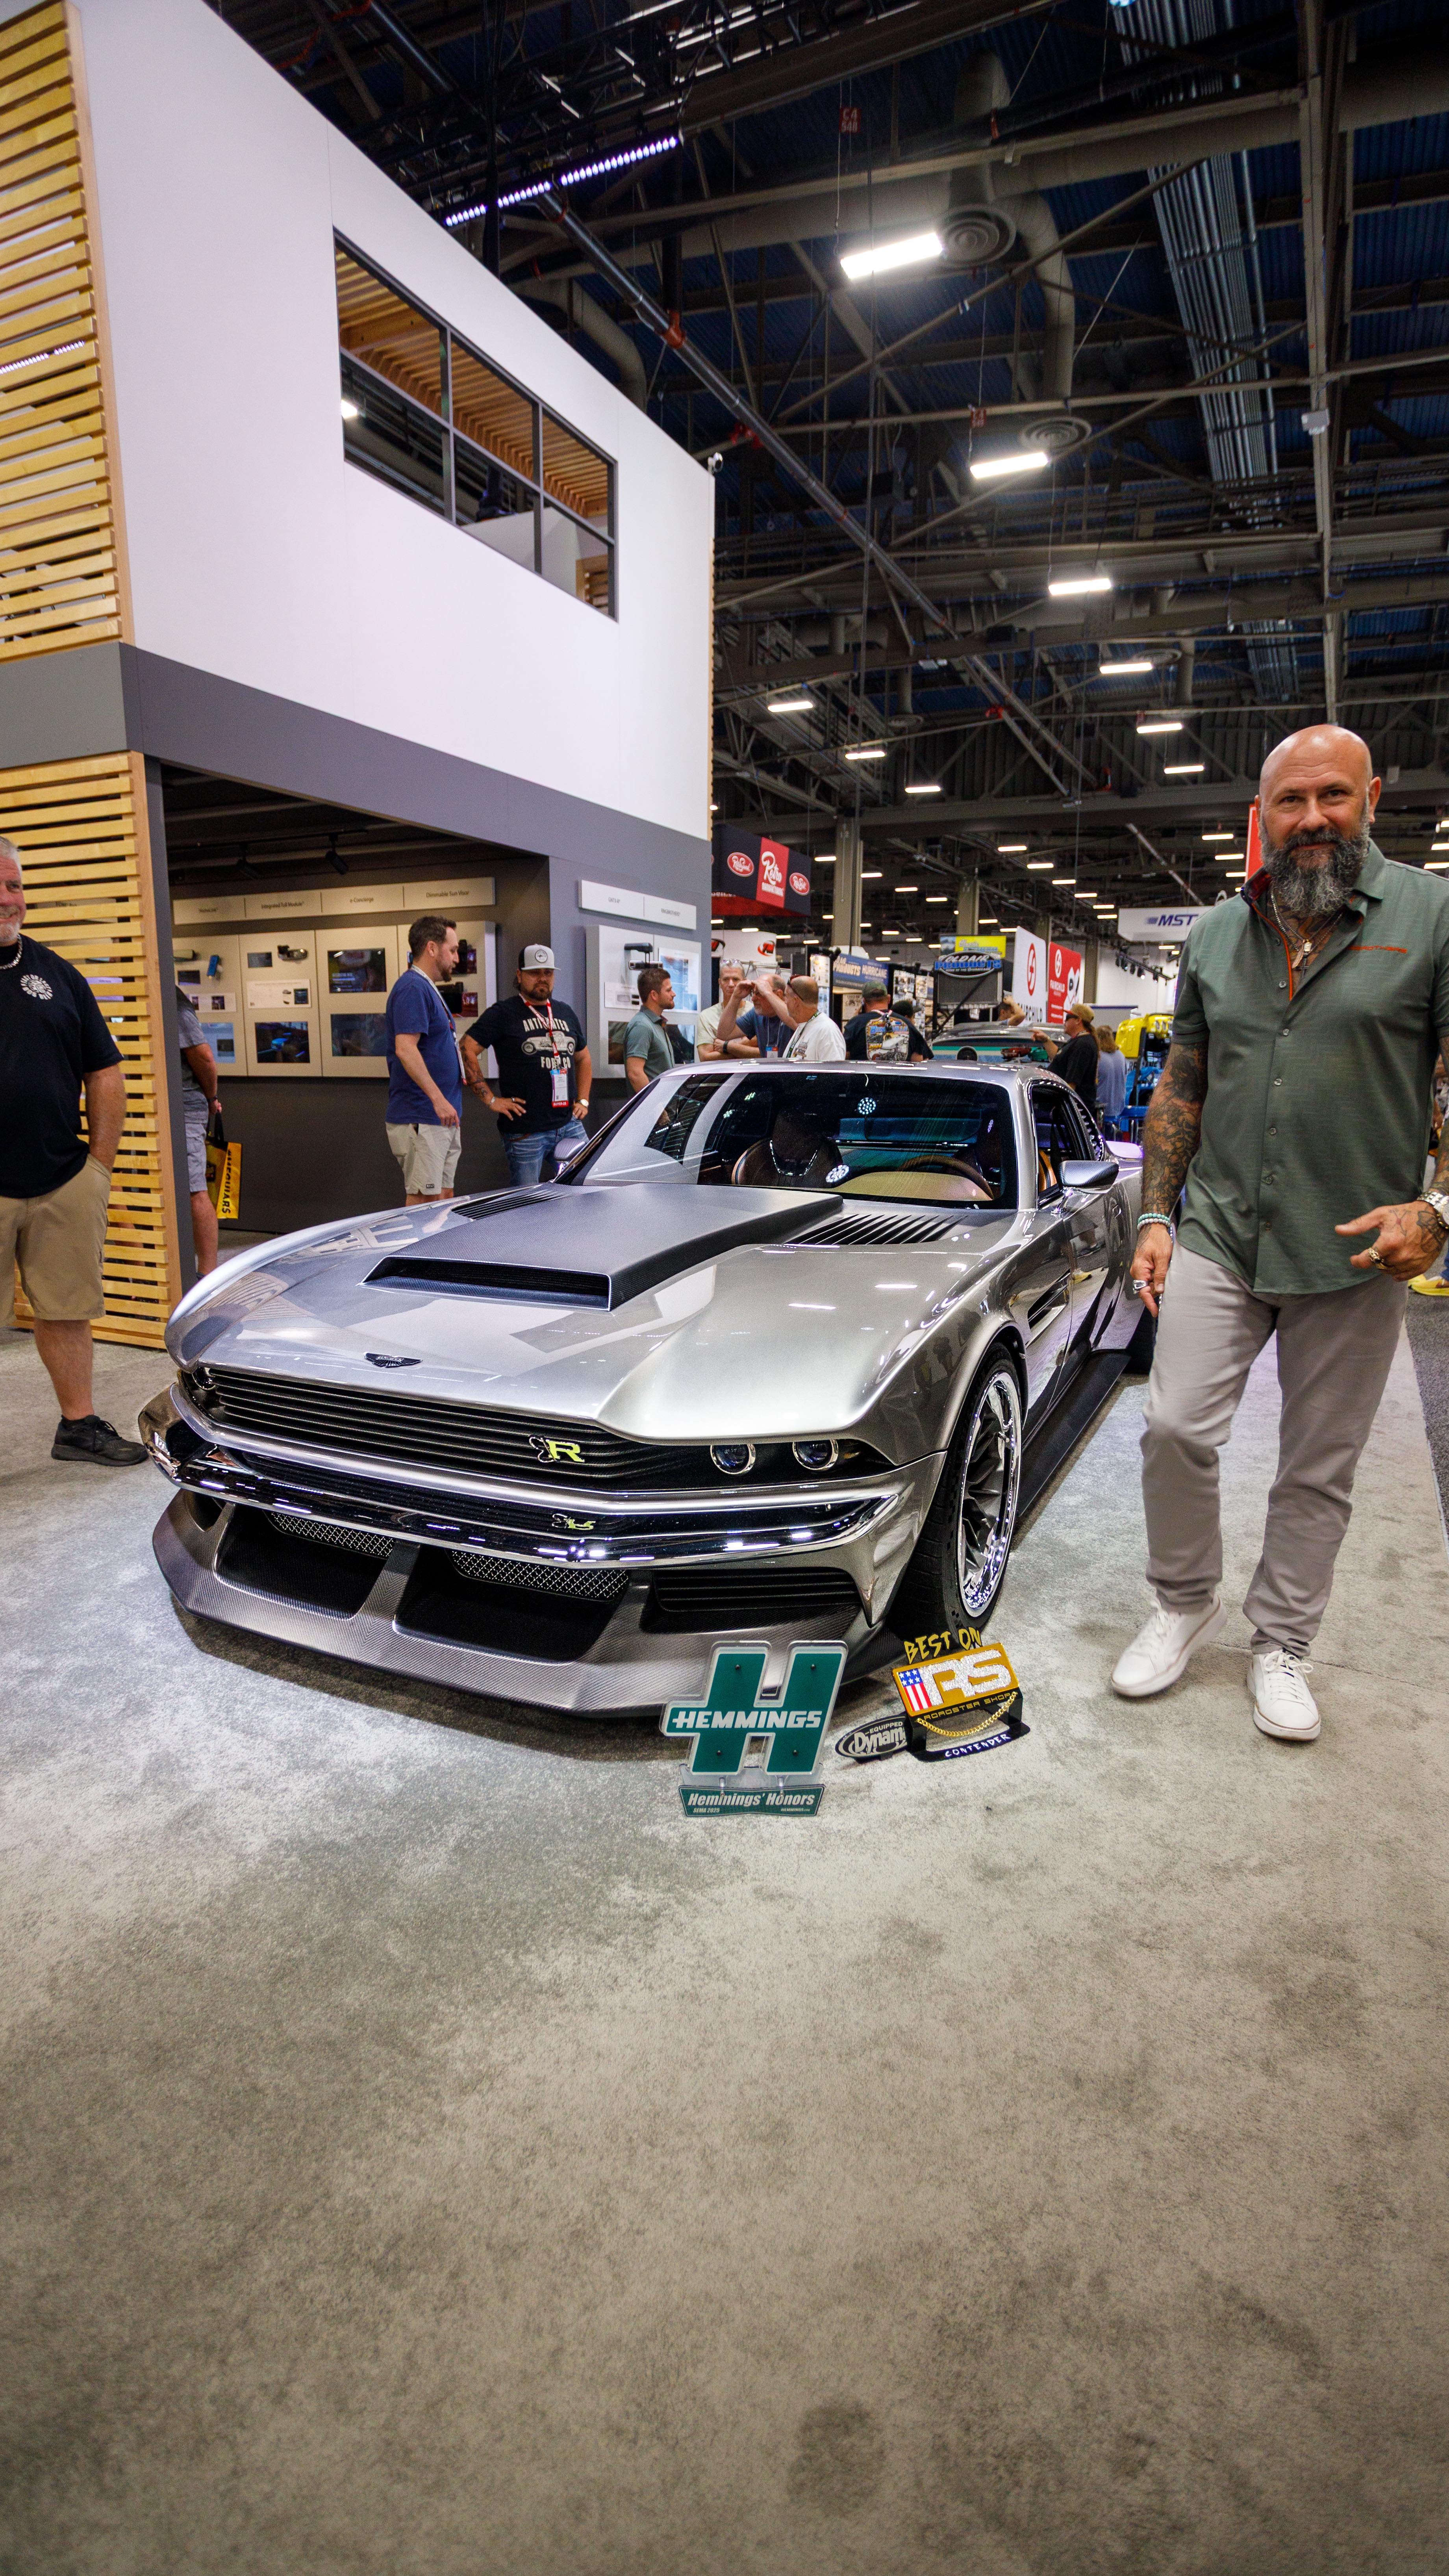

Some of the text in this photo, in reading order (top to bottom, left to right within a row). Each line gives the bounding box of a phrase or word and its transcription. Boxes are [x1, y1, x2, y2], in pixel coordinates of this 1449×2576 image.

[1158, 913, 1198, 926] MST
[862, 965, 888, 978] HURRICANE
[935, 960, 1001, 971] PRODUCTS
[563, 1056, 571, 1068] CO
[546, 1439, 585, 1462] R
[904, 1627, 982, 1664] BEST ON
[918, 1649, 1011, 1708] RS
[924, 1693, 1011, 1721] ROADSTER SHOP
[672, 1711, 823, 1728] HEMMINGS
[869, 1721, 903, 1734] EQUIPPED
[854, 1727, 906, 1754] Dynam
[945, 1733, 1011, 1757] CONTENDER
[765, 1793, 815, 1805] Honors
